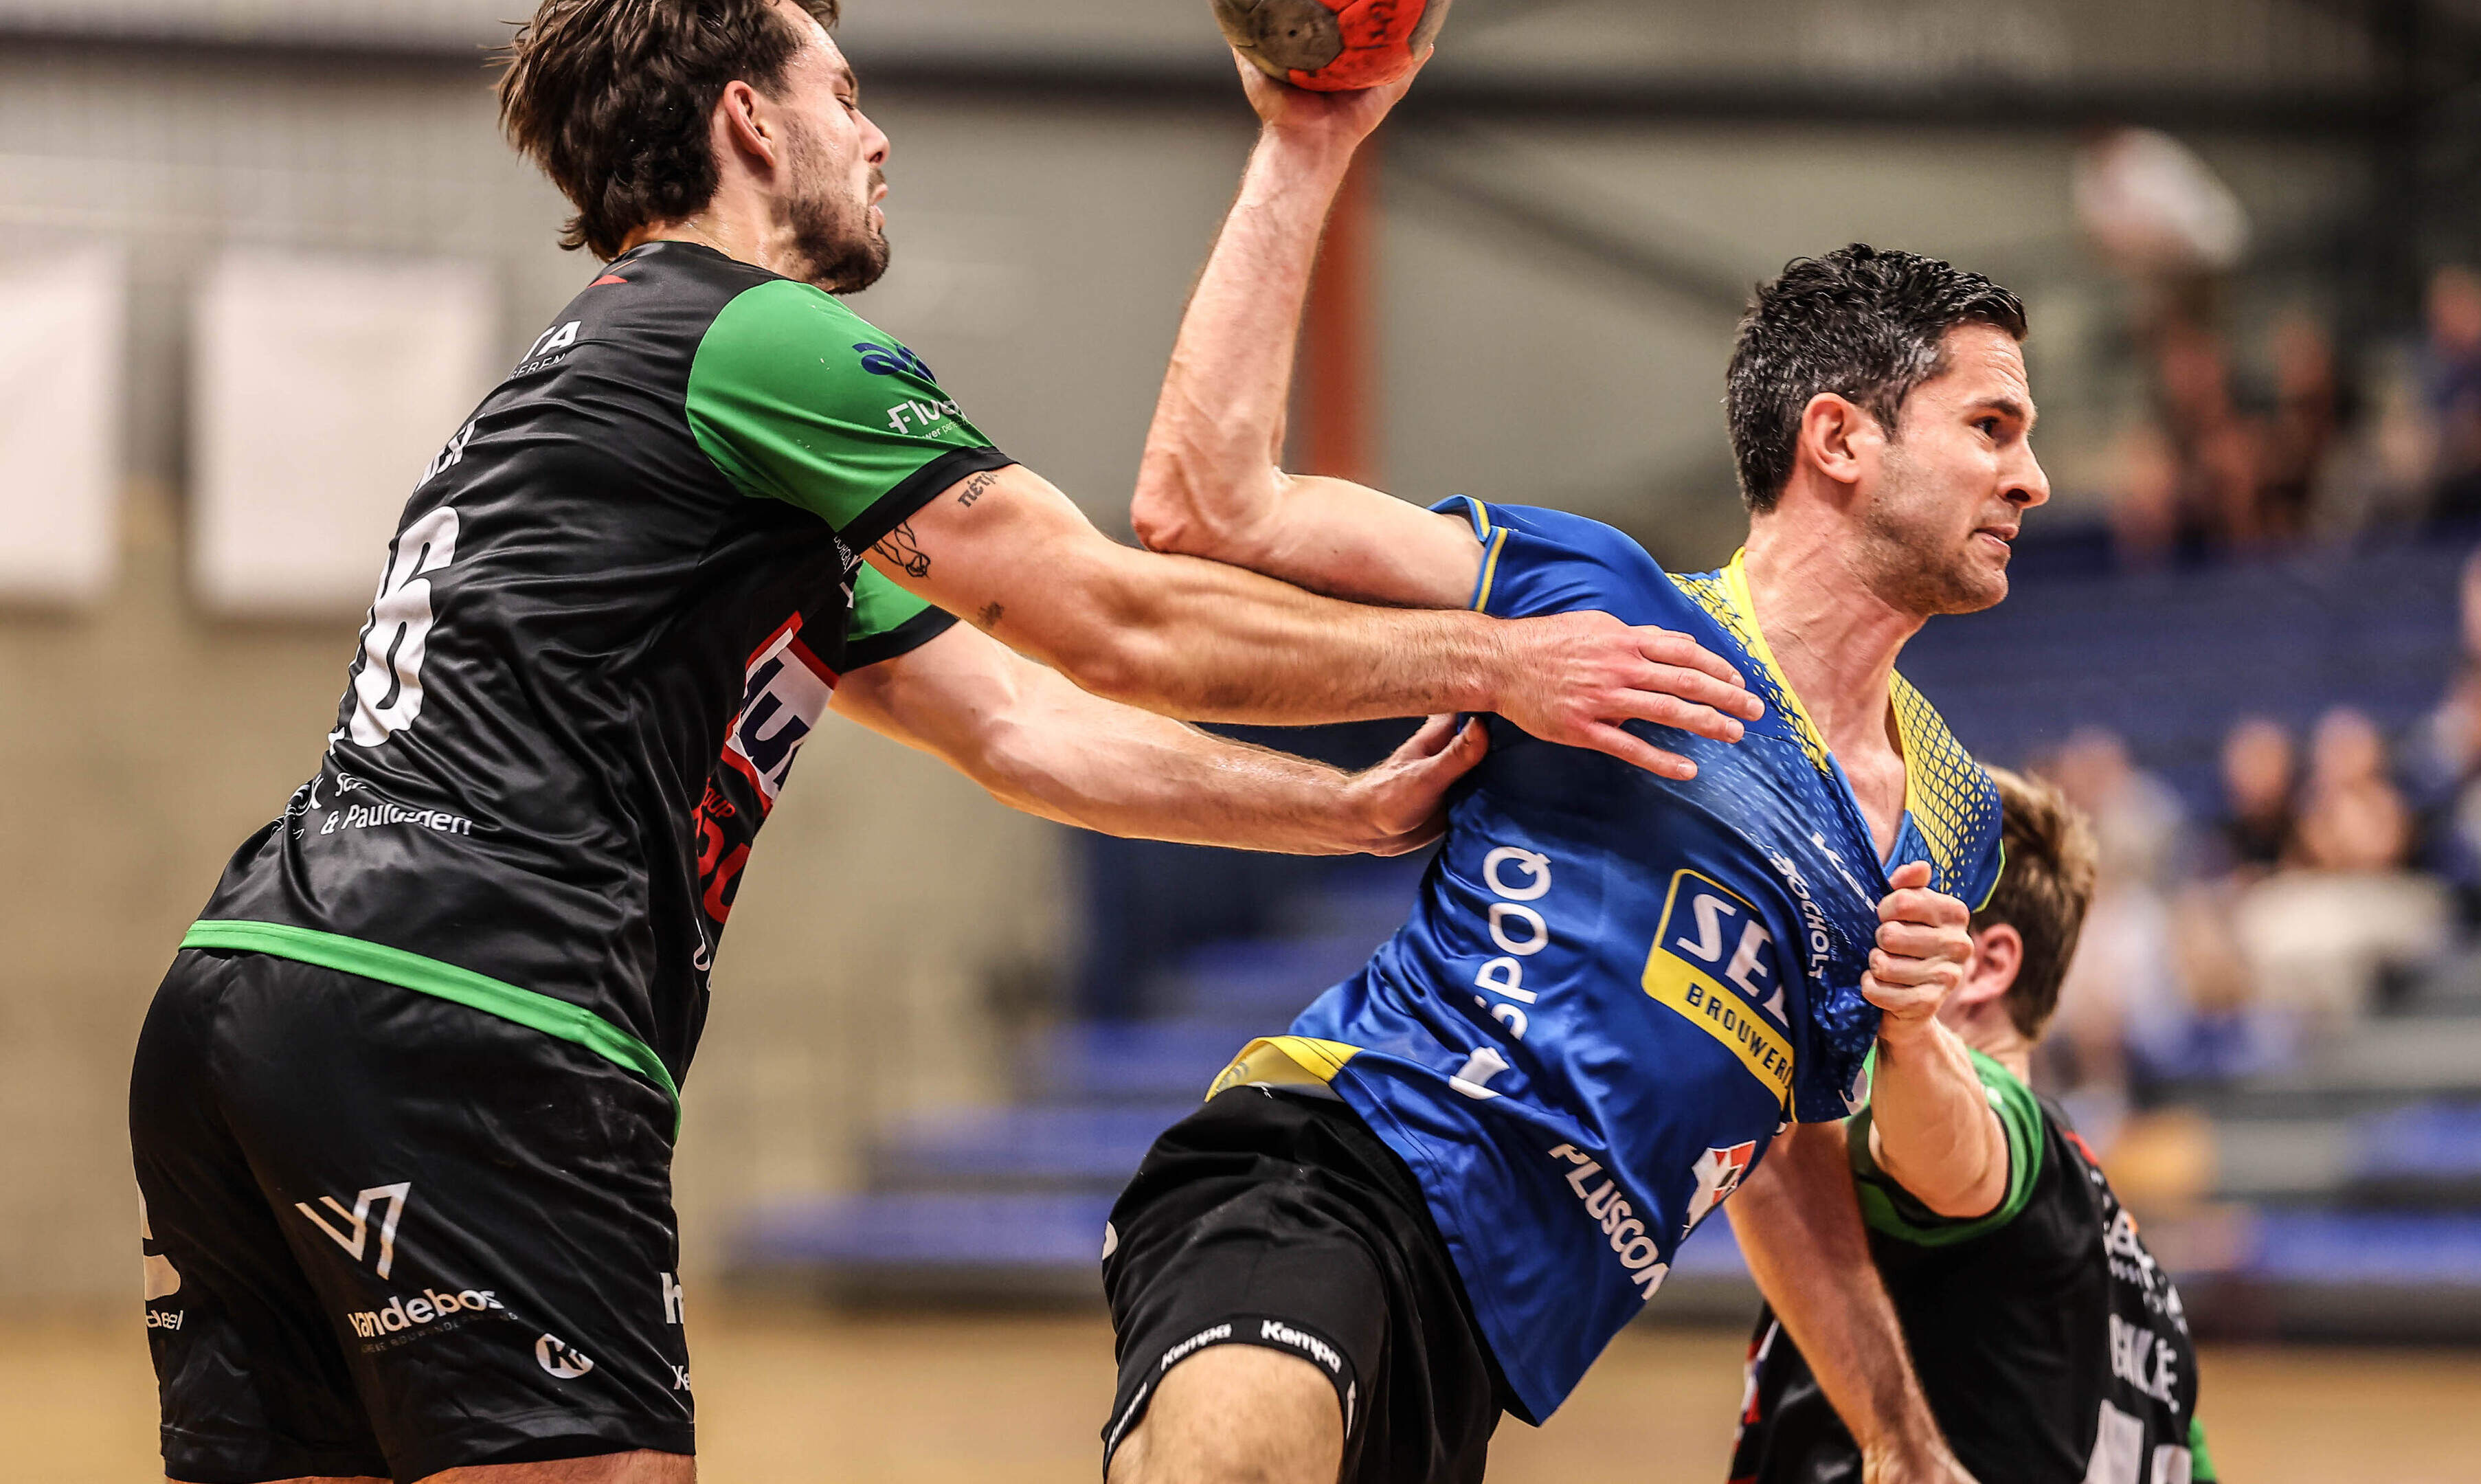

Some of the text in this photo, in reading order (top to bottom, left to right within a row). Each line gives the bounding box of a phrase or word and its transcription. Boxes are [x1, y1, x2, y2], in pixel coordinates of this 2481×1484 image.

[320, 811, 339, 835] &
[1160, 1323, 1233, 1372] Kempa
[1259, 1319, 1343, 1374] Kempa
